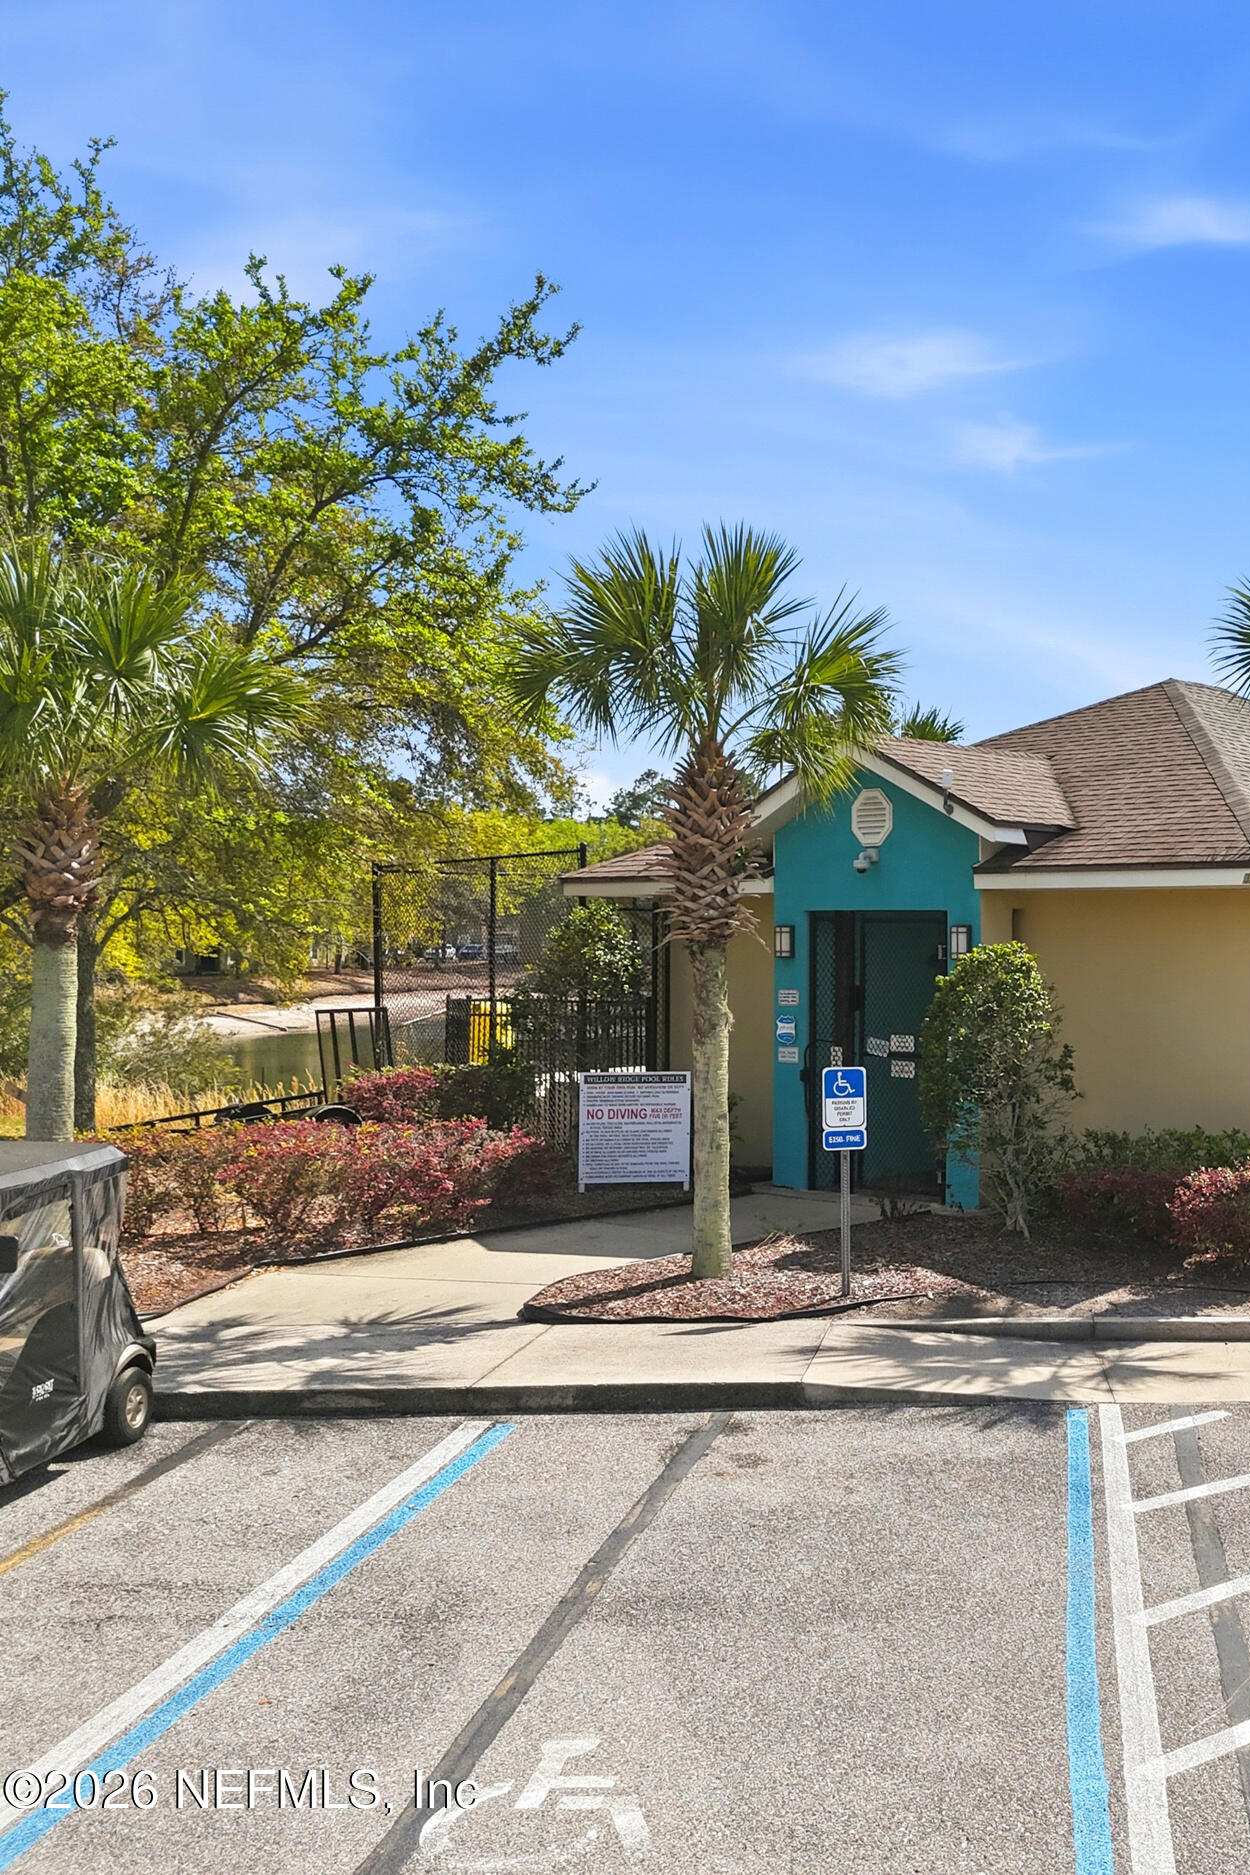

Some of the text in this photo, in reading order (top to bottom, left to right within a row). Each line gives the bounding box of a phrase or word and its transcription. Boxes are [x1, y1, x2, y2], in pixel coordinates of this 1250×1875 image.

[587, 1075, 616, 1083] WILLOW
[586, 1108, 648, 1120] NO DIVING
